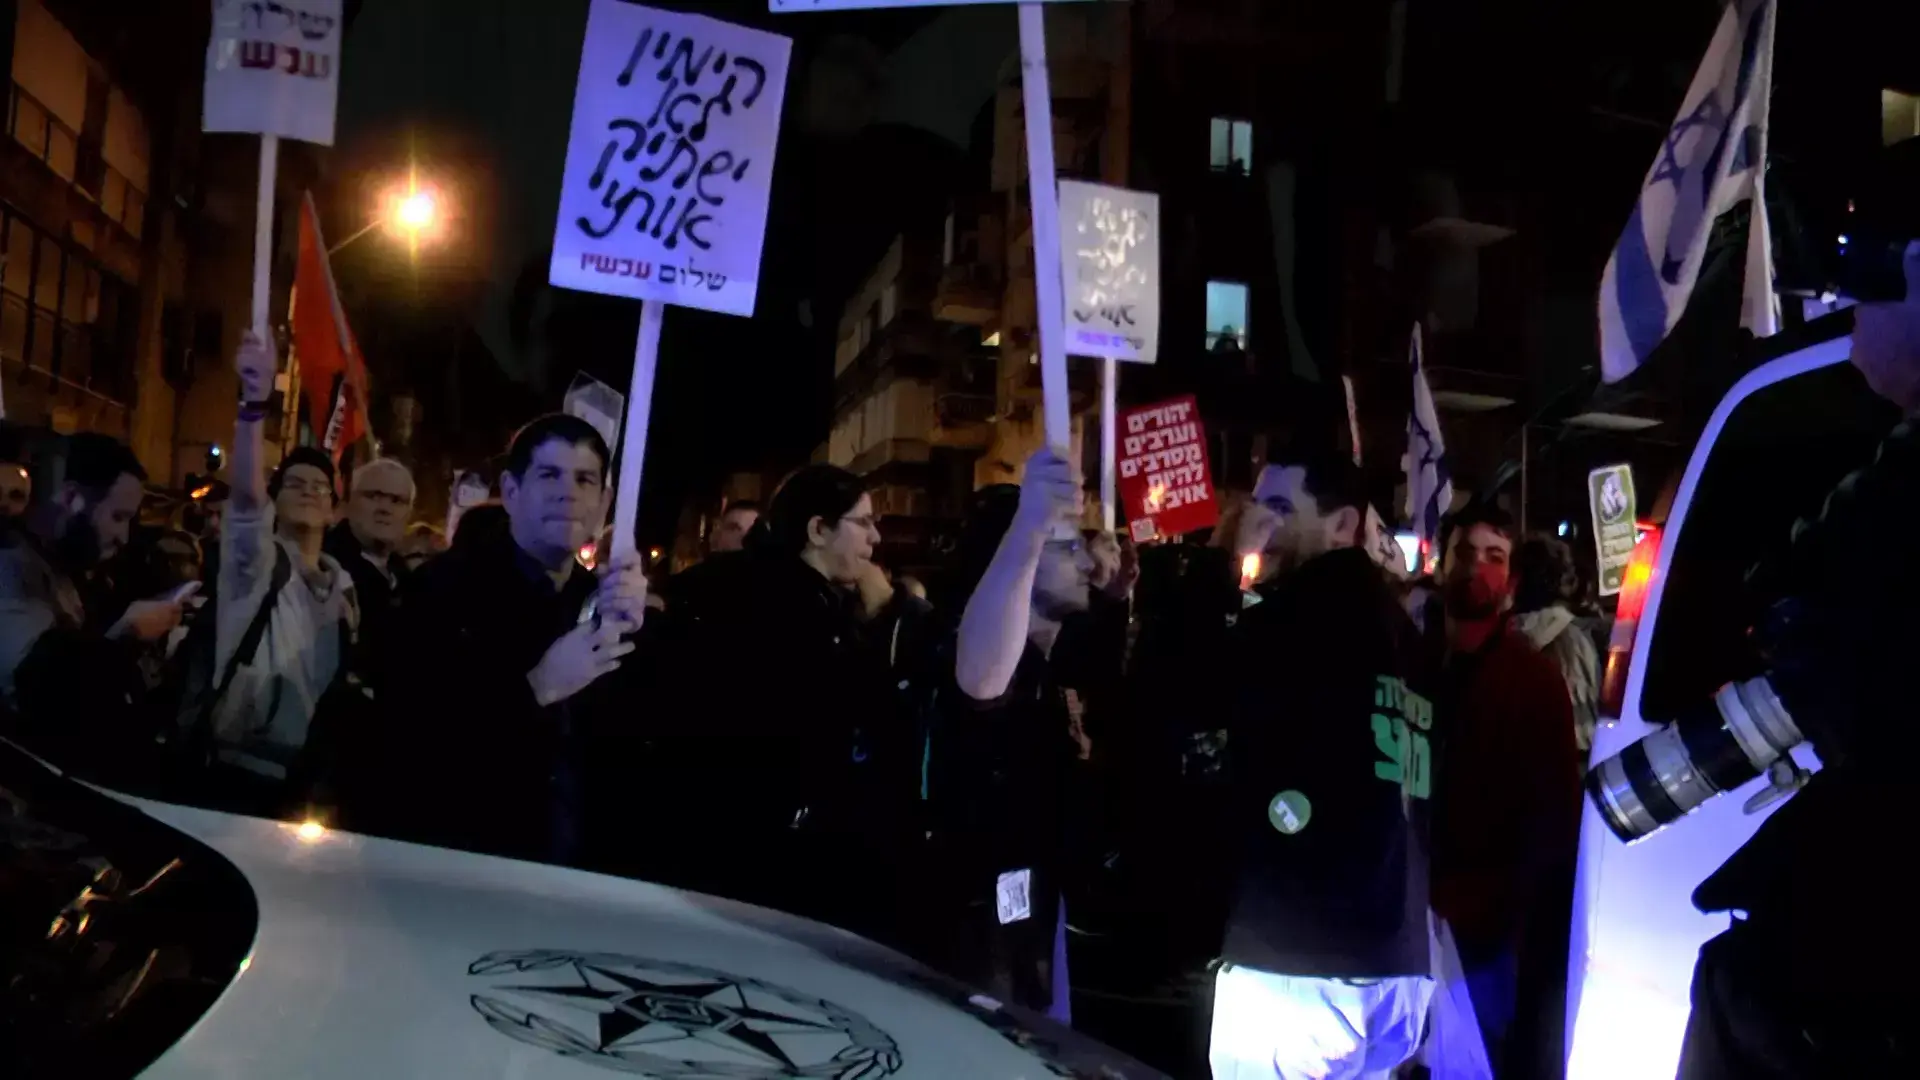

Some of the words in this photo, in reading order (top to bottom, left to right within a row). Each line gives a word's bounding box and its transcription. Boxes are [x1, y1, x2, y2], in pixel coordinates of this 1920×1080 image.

[616, 27, 767, 109] הימין
[646, 76, 736, 143] לא
[588, 118, 752, 206] ישתיק
[575, 179, 715, 251] אותי
[579, 251, 652, 281] עכשיו
[657, 257, 728, 292] שלום
[1126, 401, 1192, 434] יהודים
[1124, 421, 1198, 456] וערבים
[1119, 442, 1203, 479] מסרבים
